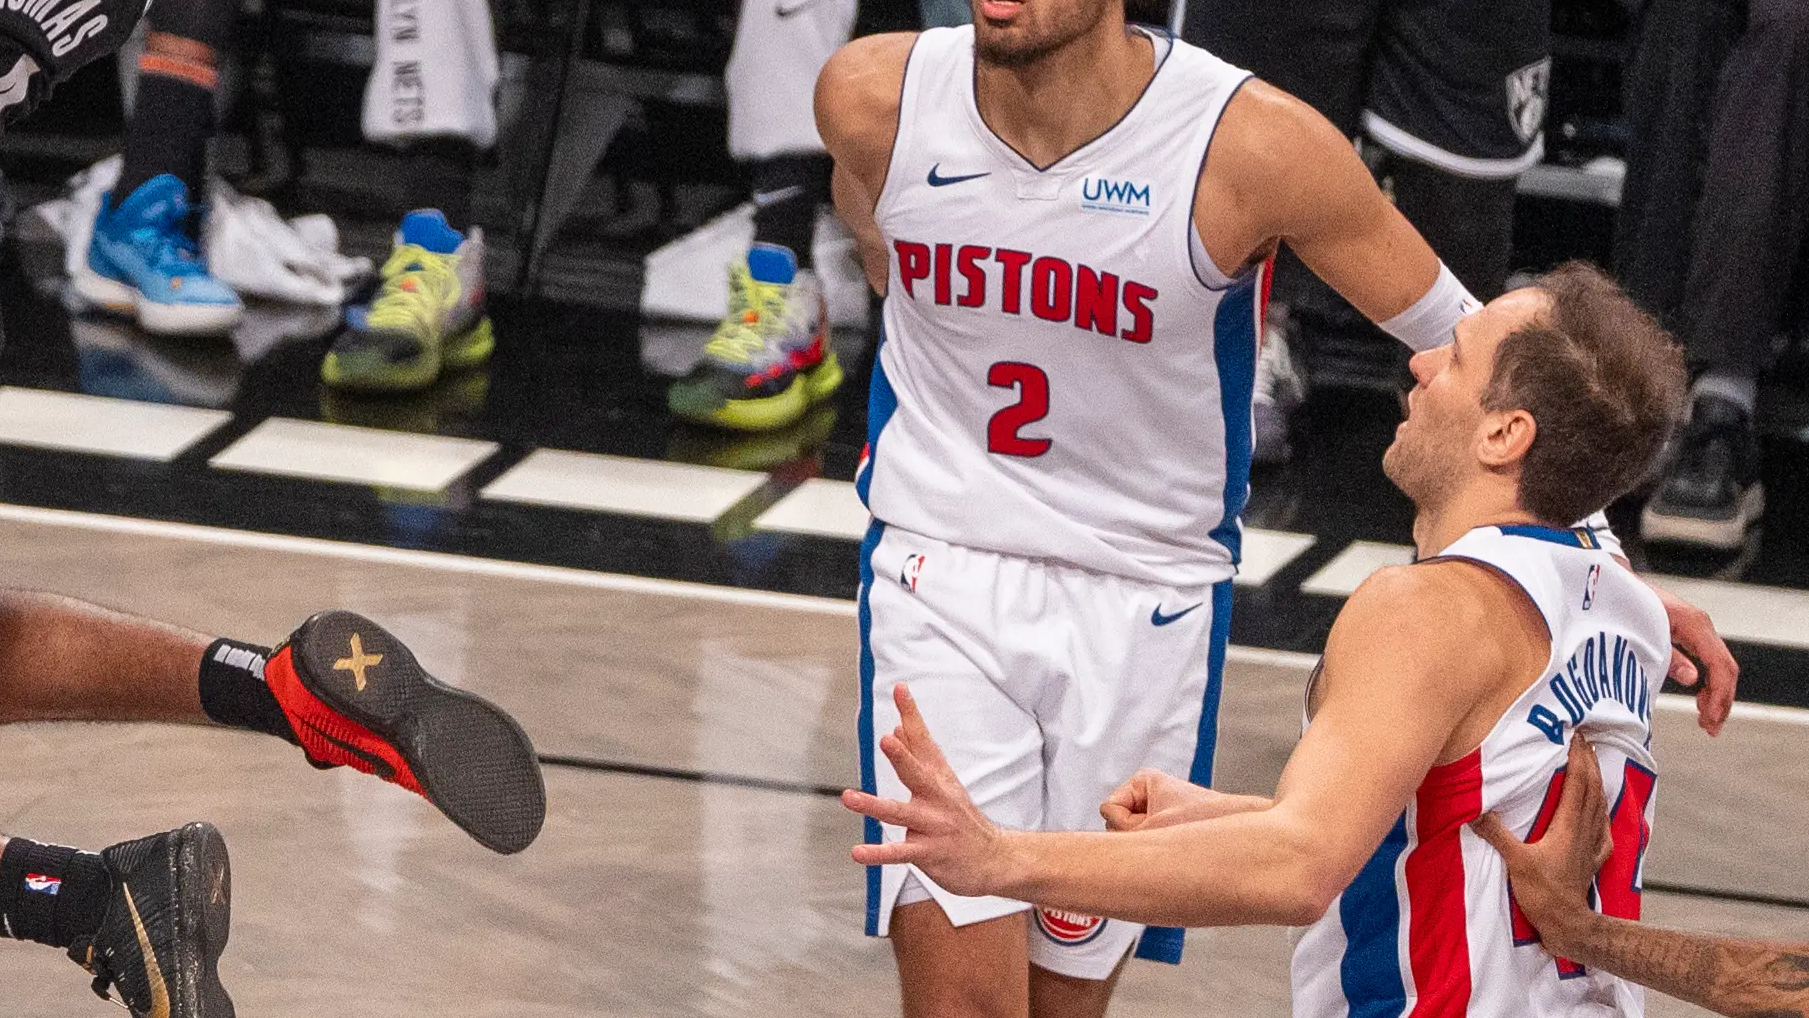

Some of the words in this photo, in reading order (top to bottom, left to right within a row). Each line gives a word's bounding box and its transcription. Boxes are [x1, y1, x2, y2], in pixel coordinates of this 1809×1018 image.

[392, 61, 425, 125] NETS
[1083, 177, 1150, 207] UWM
[893, 239, 1159, 345] PISTONS
[987, 360, 1053, 458] 2
[1526, 630, 1652, 752] BOGDANOV
